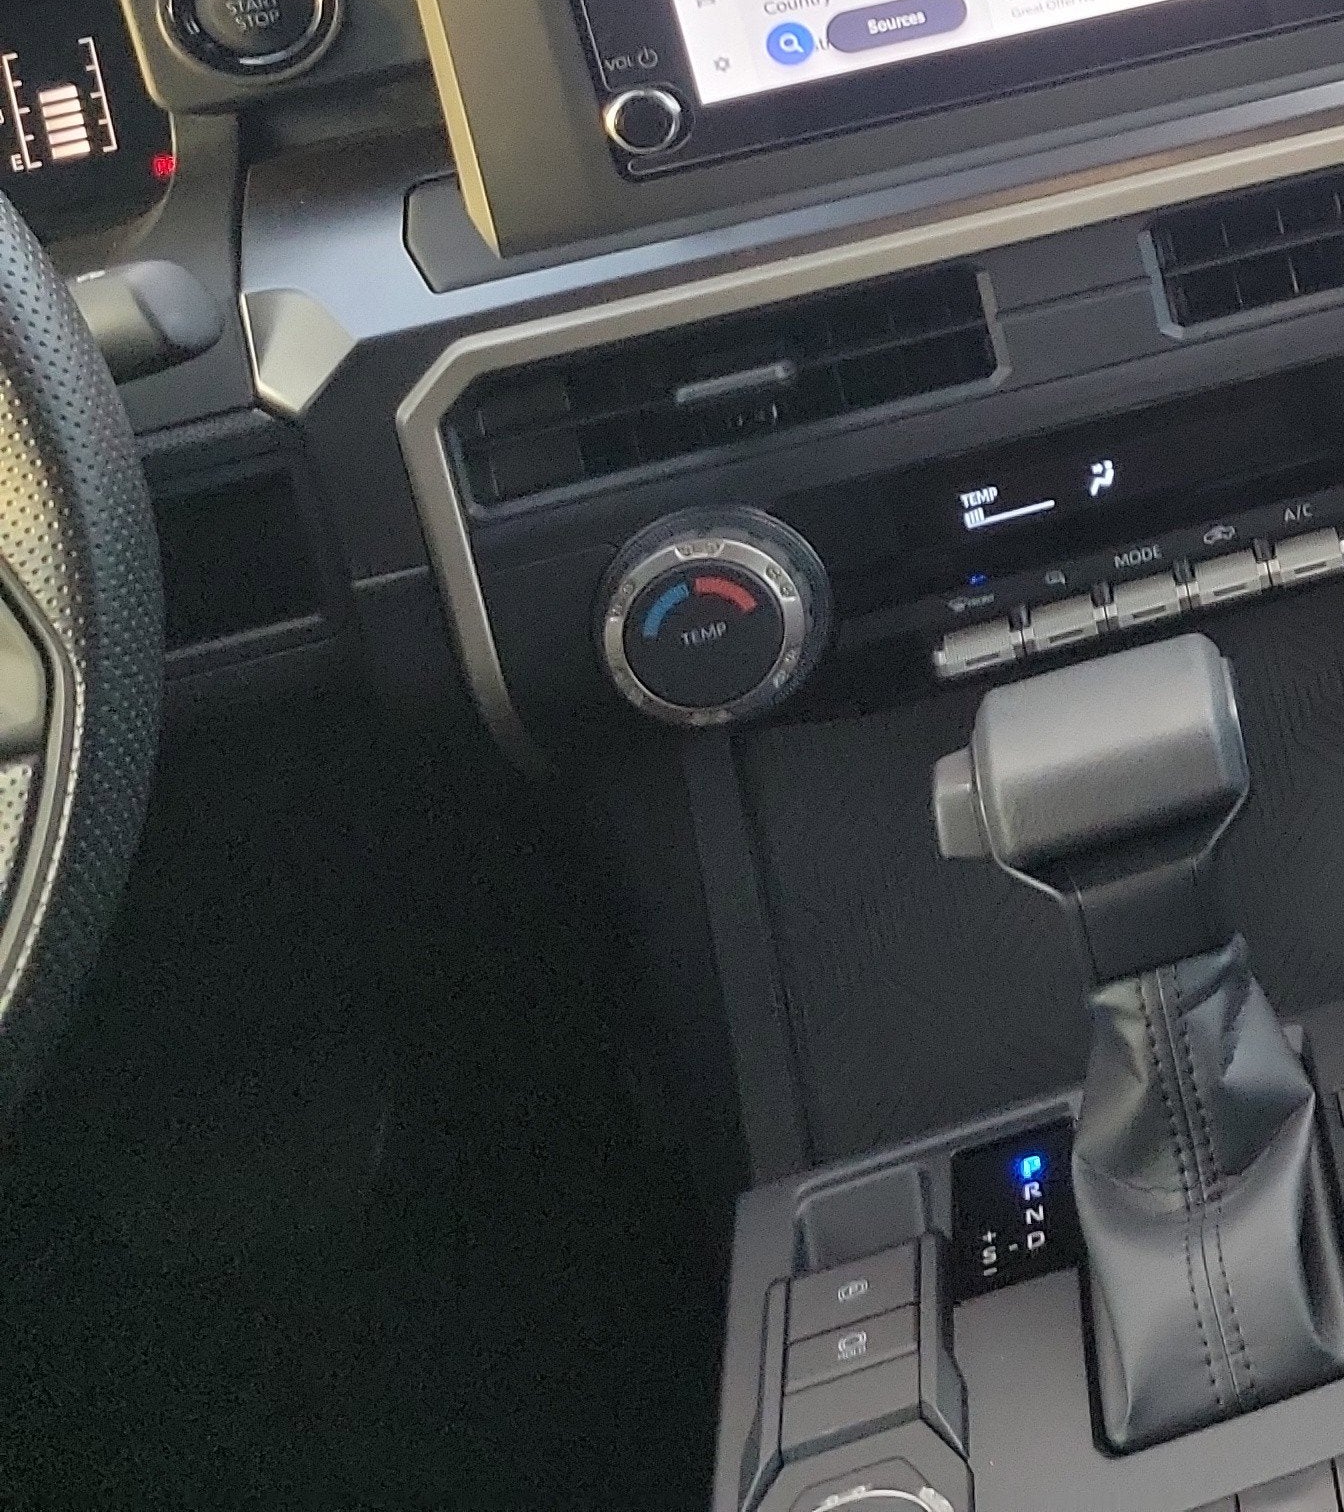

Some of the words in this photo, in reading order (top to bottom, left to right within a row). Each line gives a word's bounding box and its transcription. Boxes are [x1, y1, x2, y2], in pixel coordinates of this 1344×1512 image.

[235, 10, 281, 31] STOP
[866, 9, 927, 36] Sources
[603, 55, 632, 72] VOL
[11, 153, 25, 173] E
[959, 486, 999, 510] TEMP
[1283, 502, 1314, 524] A/C
[1112, 544, 1163, 570] MODE
[681, 620, 728, 646] TEMP
[1024, 1181, 1042, 1201] R
[1025, 1204, 1044, 1225] N
[1027, 1230, 1046, 1251] D
